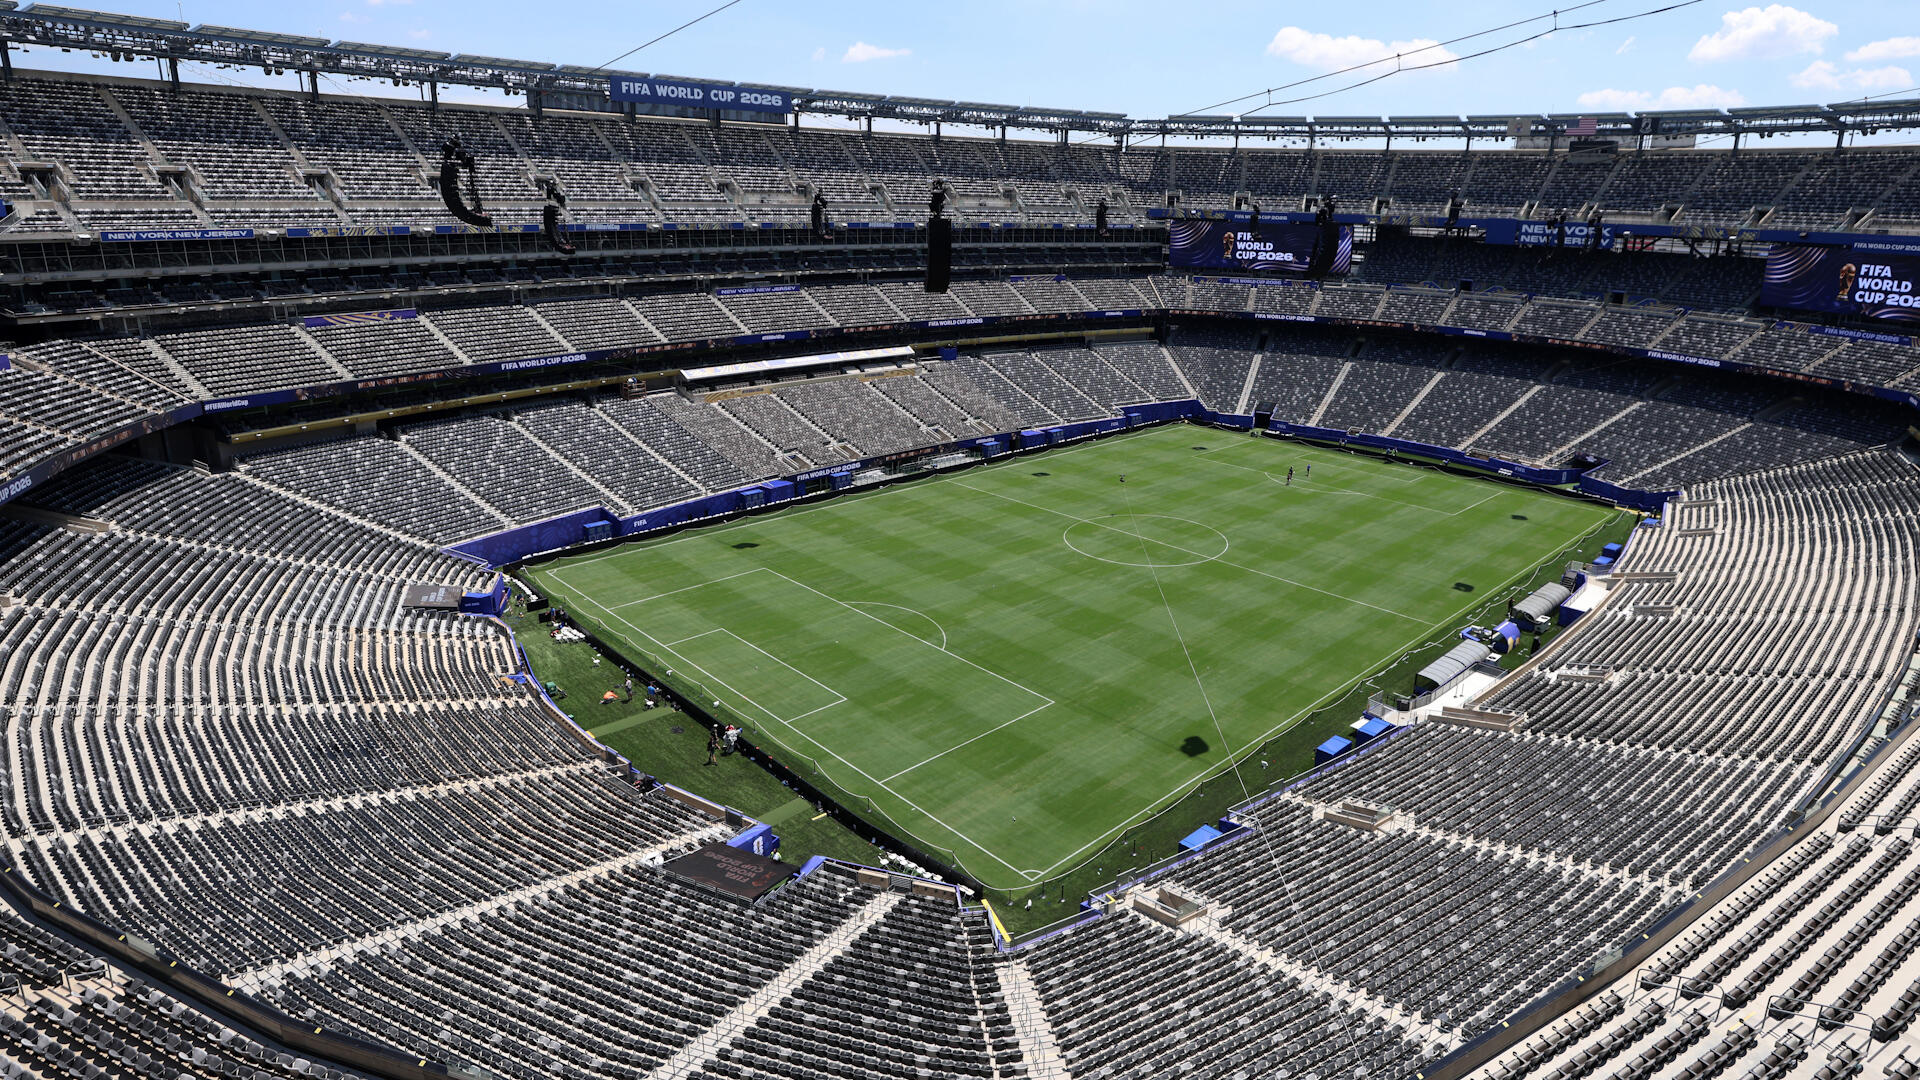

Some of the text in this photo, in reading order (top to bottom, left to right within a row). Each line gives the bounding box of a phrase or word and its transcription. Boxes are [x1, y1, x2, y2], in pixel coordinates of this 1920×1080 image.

[621, 81, 782, 106] FIFA WORLD CUP 2026
[108, 229, 247, 240] NEW YORK NEW JERSEY
[1521, 224, 1558, 235] NEW
[1237, 232, 1254, 241] FIF
[1553, 236, 1610, 246] ERY
[1236, 241, 1274, 251] WORLD
[1236, 251, 1294, 261] CUP 2026
[1860, 264, 1892, 278] FIFA
[1858, 277, 1912, 293] WORLD
[1855, 291, 1920, 308] CUP 202
[1839, 330, 1861, 338] WORLD
[1862, 332, 1875, 340] CUP
[501, 354, 587, 370] FIFA WORLD CUP 2026
[1662, 353, 1685, 361] WORLD
[1698, 358, 1720, 367] 2026
[796, 462, 862, 482] FIFA WORLD CUP 2026
[0, 475, 32, 501] UP 2026
[633, 519, 648, 528] FIFA
